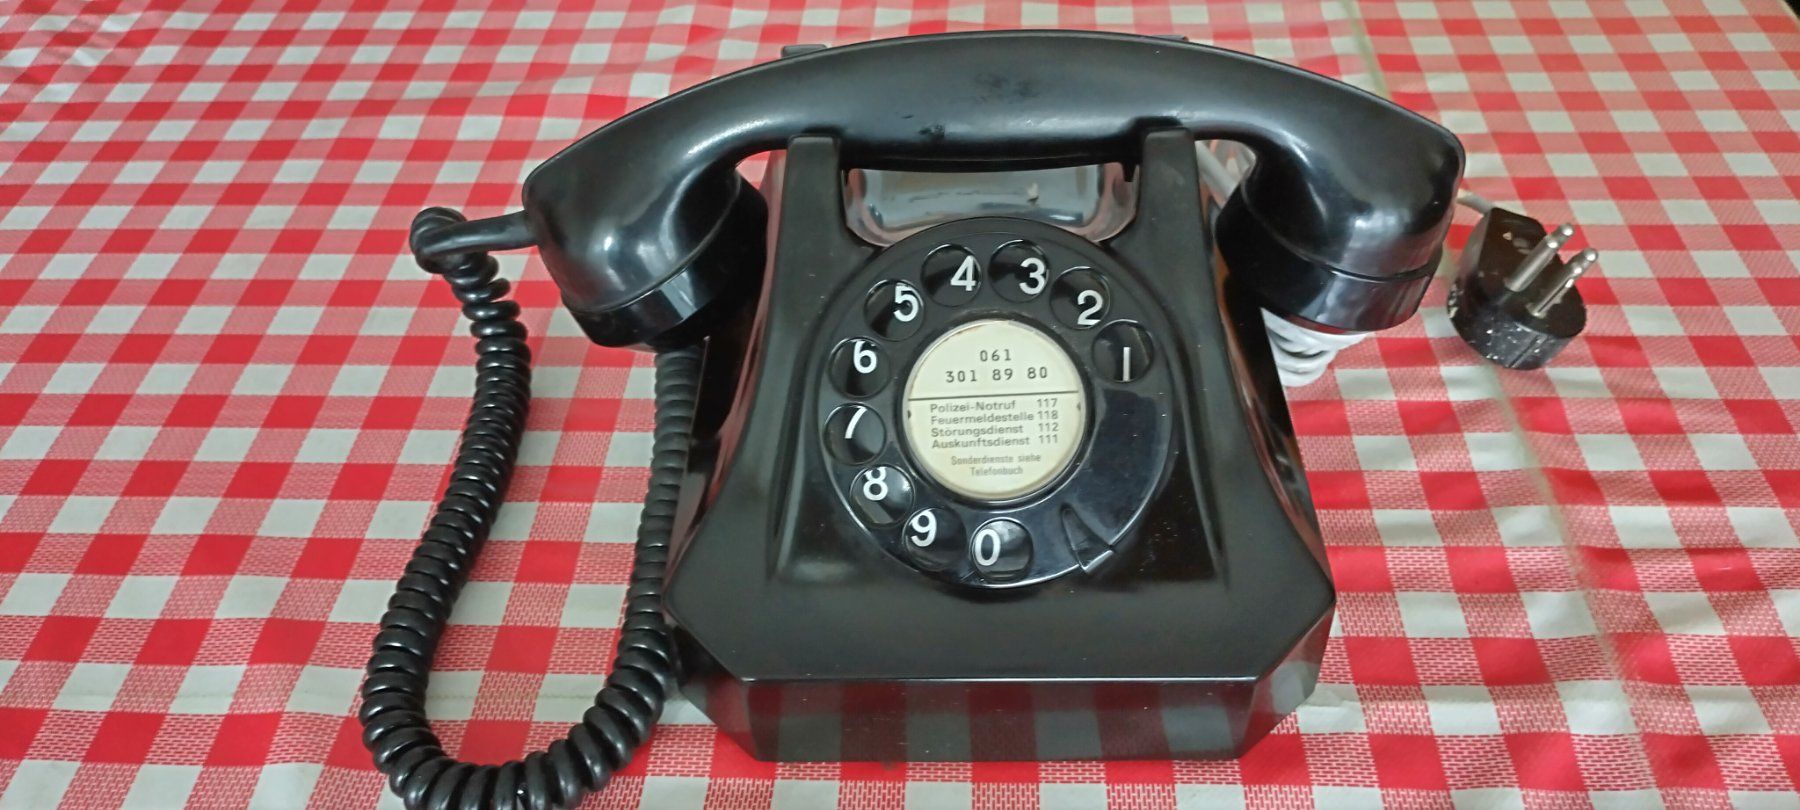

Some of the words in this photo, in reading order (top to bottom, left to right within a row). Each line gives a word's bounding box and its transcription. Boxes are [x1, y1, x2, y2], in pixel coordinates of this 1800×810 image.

[950, 255, 976, 291] 4
[1019, 257, 1046, 294] 3
[892, 285, 919, 322] 5
[1076, 289, 1103, 325] 2
[852, 340, 878, 373] 6
[979, 349, 1012, 362] 061
[945, 369, 977, 383] 301
[992, 367, 1013, 381] 89
[1027, 366, 1048, 379] 80
[930, 400, 1017, 413] Polizei-Notruf
[1037, 398, 1058, 408] 117
[931, 412, 1035, 425] Feuermeldestelle
[1037, 410, 1059, 421] 118
[844, 406, 867, 439] 7
[1038, 423, 1060, 433] 112
[932, 436, 1031, 449] Auskunftsdienst
[1038, 434, 1059, 444] 111
[951, 456, 1014, 466] Sonderdienste
[1018, 454, 1041, 463] siehe
[971, 467, 1024, 477] Telefonbuch
[863, 466, 888, 501] 8
[910, 510, 937, 547] 9
[974, 529, 1001, 566] 0
